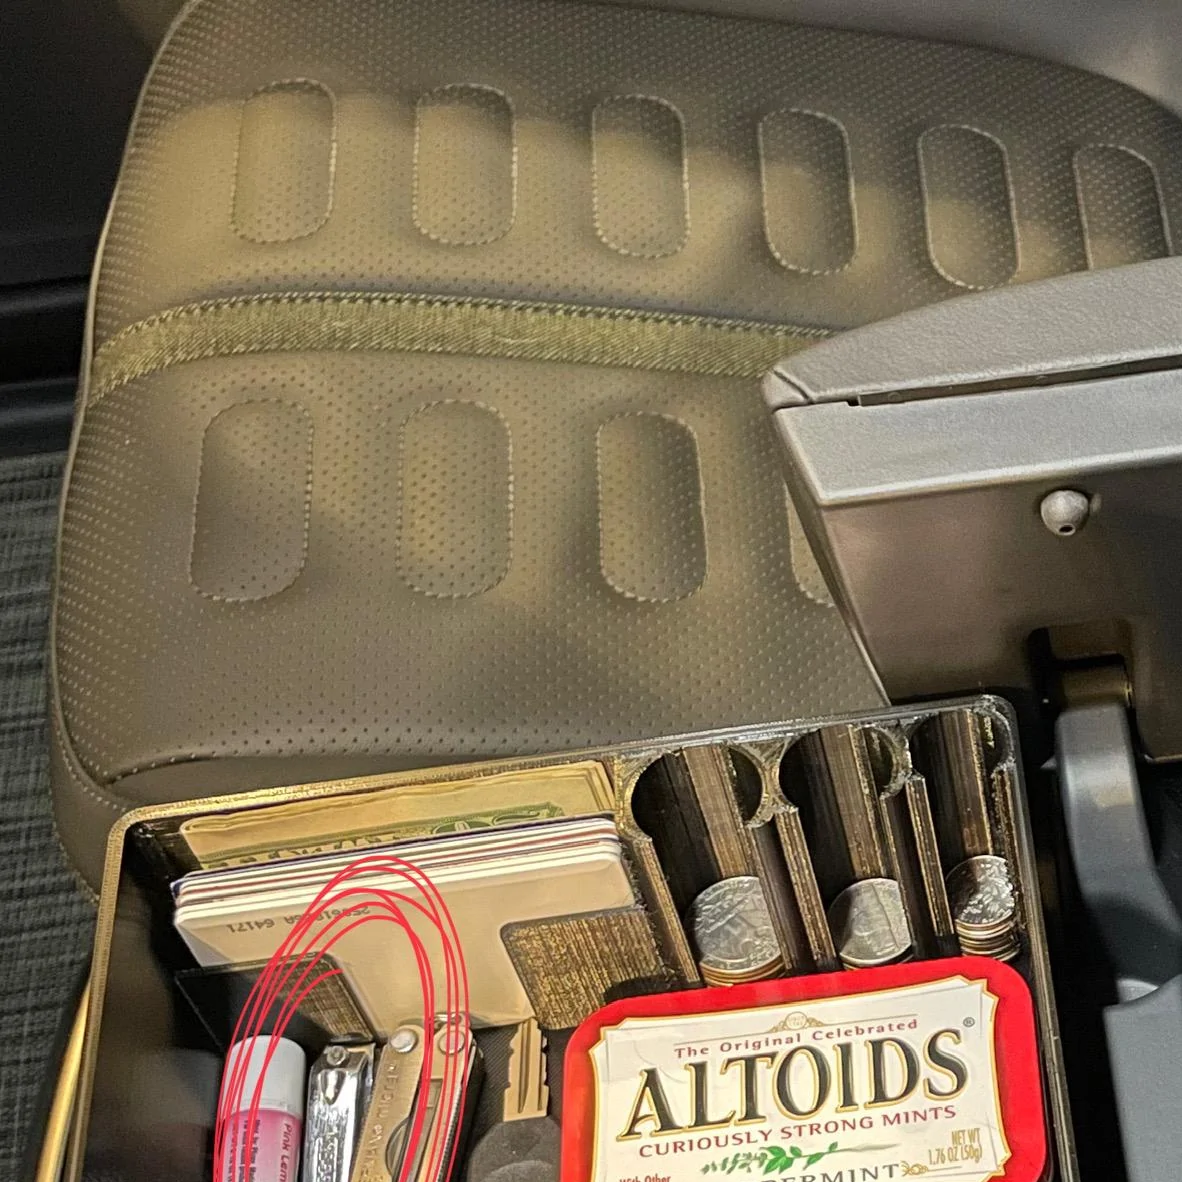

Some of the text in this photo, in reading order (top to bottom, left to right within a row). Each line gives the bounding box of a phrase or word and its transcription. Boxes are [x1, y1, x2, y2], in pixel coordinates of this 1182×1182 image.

[226, 918, 275, 933] 64171
[674, 1045, 709, 1060] The
[720, 1033, 801, 1053] Original
[812, 1018, 918, 1041] Celebrated
[280, 1123, 293, 1149] Pink
[639, 1104, 957, 1158] CURIOUSLY STRONG MINTS
[951, 1128, 980, 1145] NET WT
[928, 1148, 946, 1165] 1.76
